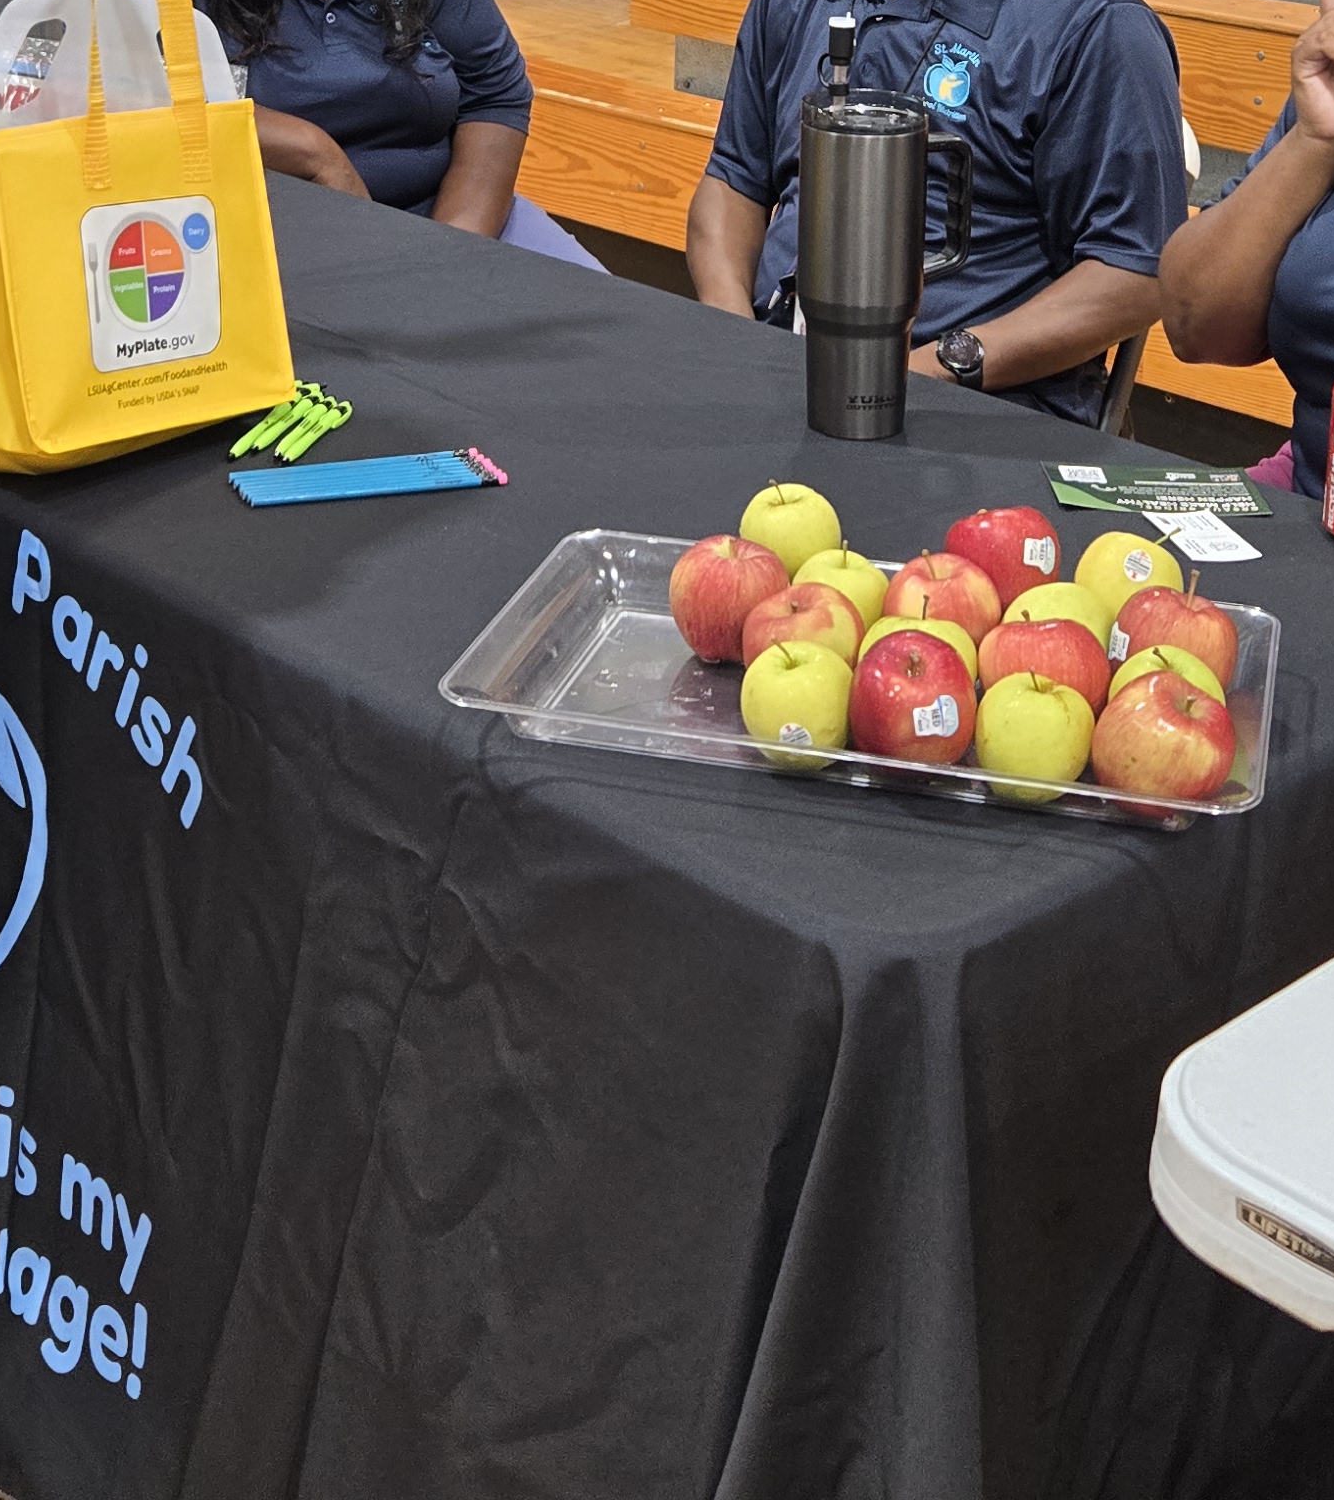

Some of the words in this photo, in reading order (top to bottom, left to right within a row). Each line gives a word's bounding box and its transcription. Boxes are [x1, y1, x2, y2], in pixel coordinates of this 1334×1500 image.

[188, 227, 205, 237] Dairy
[118, 247, 136, 256] Fruits
[150, 248, 172, 257] Grains
[113, 281, 144, 293] Vegetables
[153, 283, 176, 294] Protein
[117, 334, 195, 358] MyPlate.gov
[87, 361, 228, 397] LSUAgCenter.com/FoodandHealth
[118, 396, 145, 409] Funded
[146, 395, 155, 406] by
[156, 389, 181, 402] USDA's
[182, 385, 200, 396] SNAP
[12, 528, 203, 829] Parish
[60, 1153, 152, 1294] my
